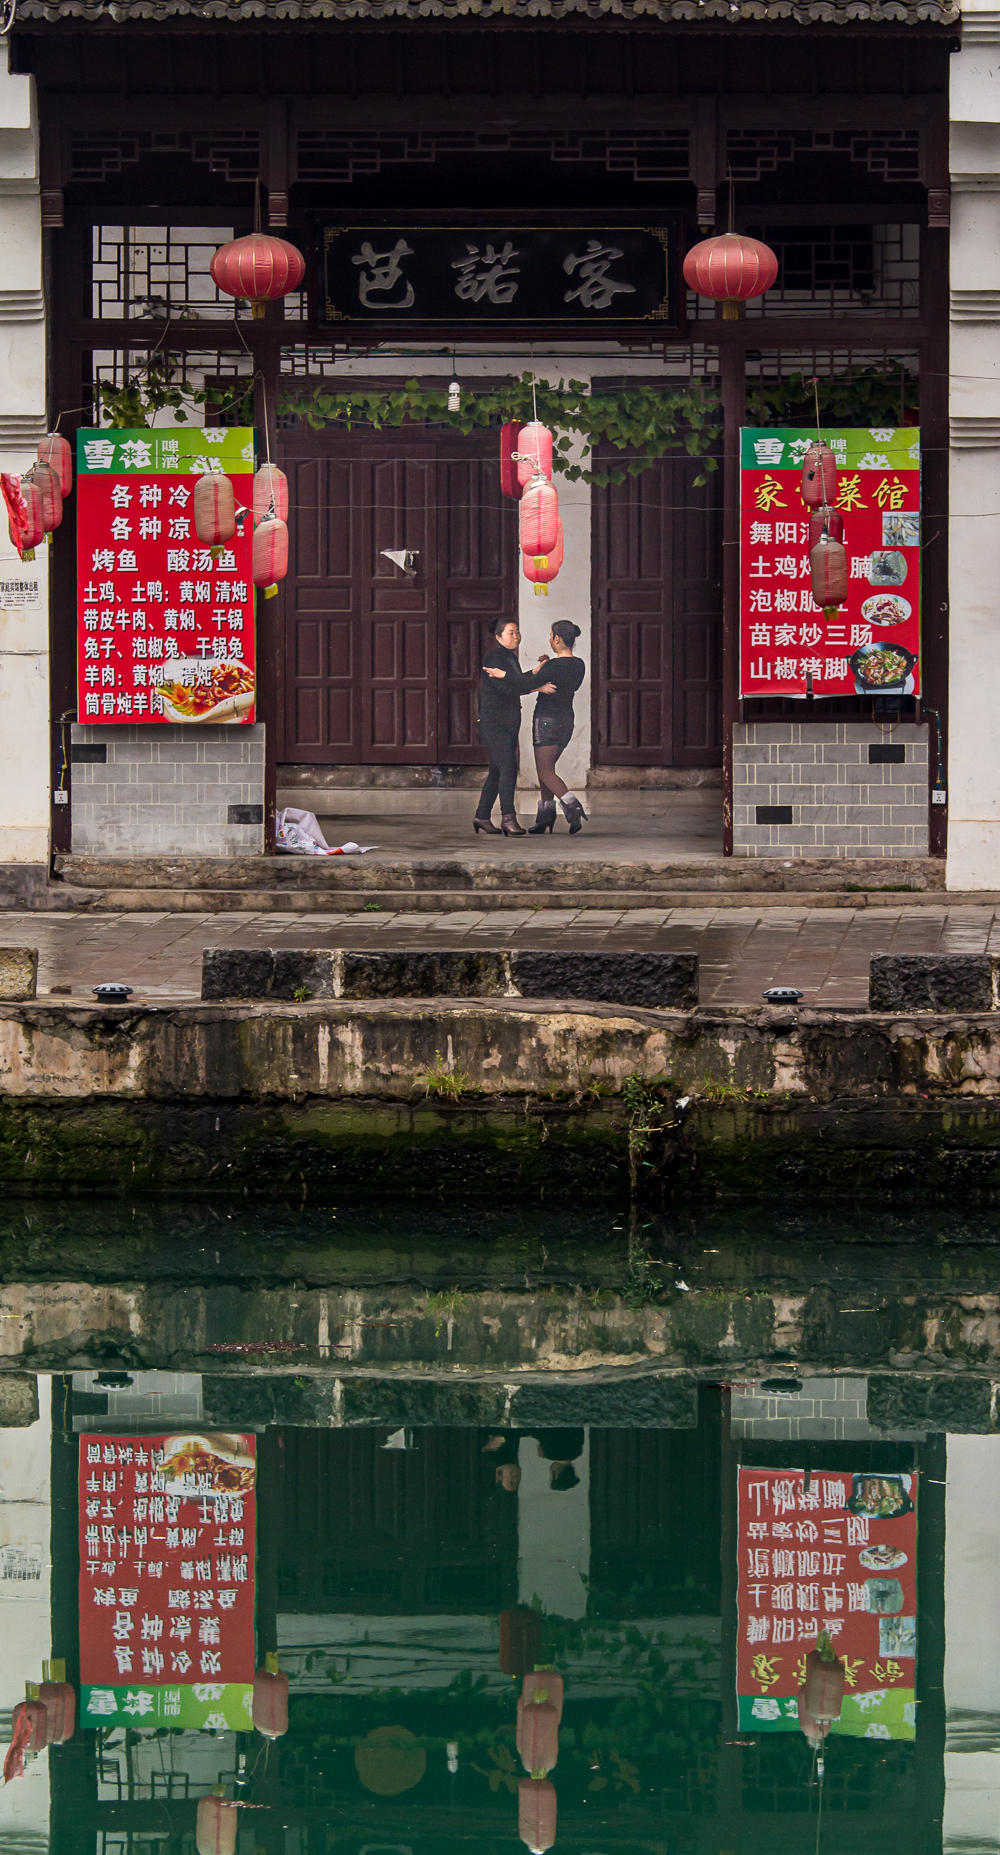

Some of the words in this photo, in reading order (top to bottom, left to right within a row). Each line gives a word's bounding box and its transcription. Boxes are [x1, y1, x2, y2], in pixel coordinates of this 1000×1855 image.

[83, 439, 152, 470] 雪花
[161, 439, 179, 469] 啤酒
[110, 484, 191, 509] 各种冷
[110, 516, 191, 541] 各种凉
[92, 549, 139, 573] 烤鱼
[167, 549, 238, 573] 酸汤鱼
[749, 589, 848, 613] 泡椒脆
[749, 623, 873, 647] 苗家炒三肠
[750, 656, 848, 681] 山椒猪脚
[85, 692, 165, 716] 筒骨炖羊肉
